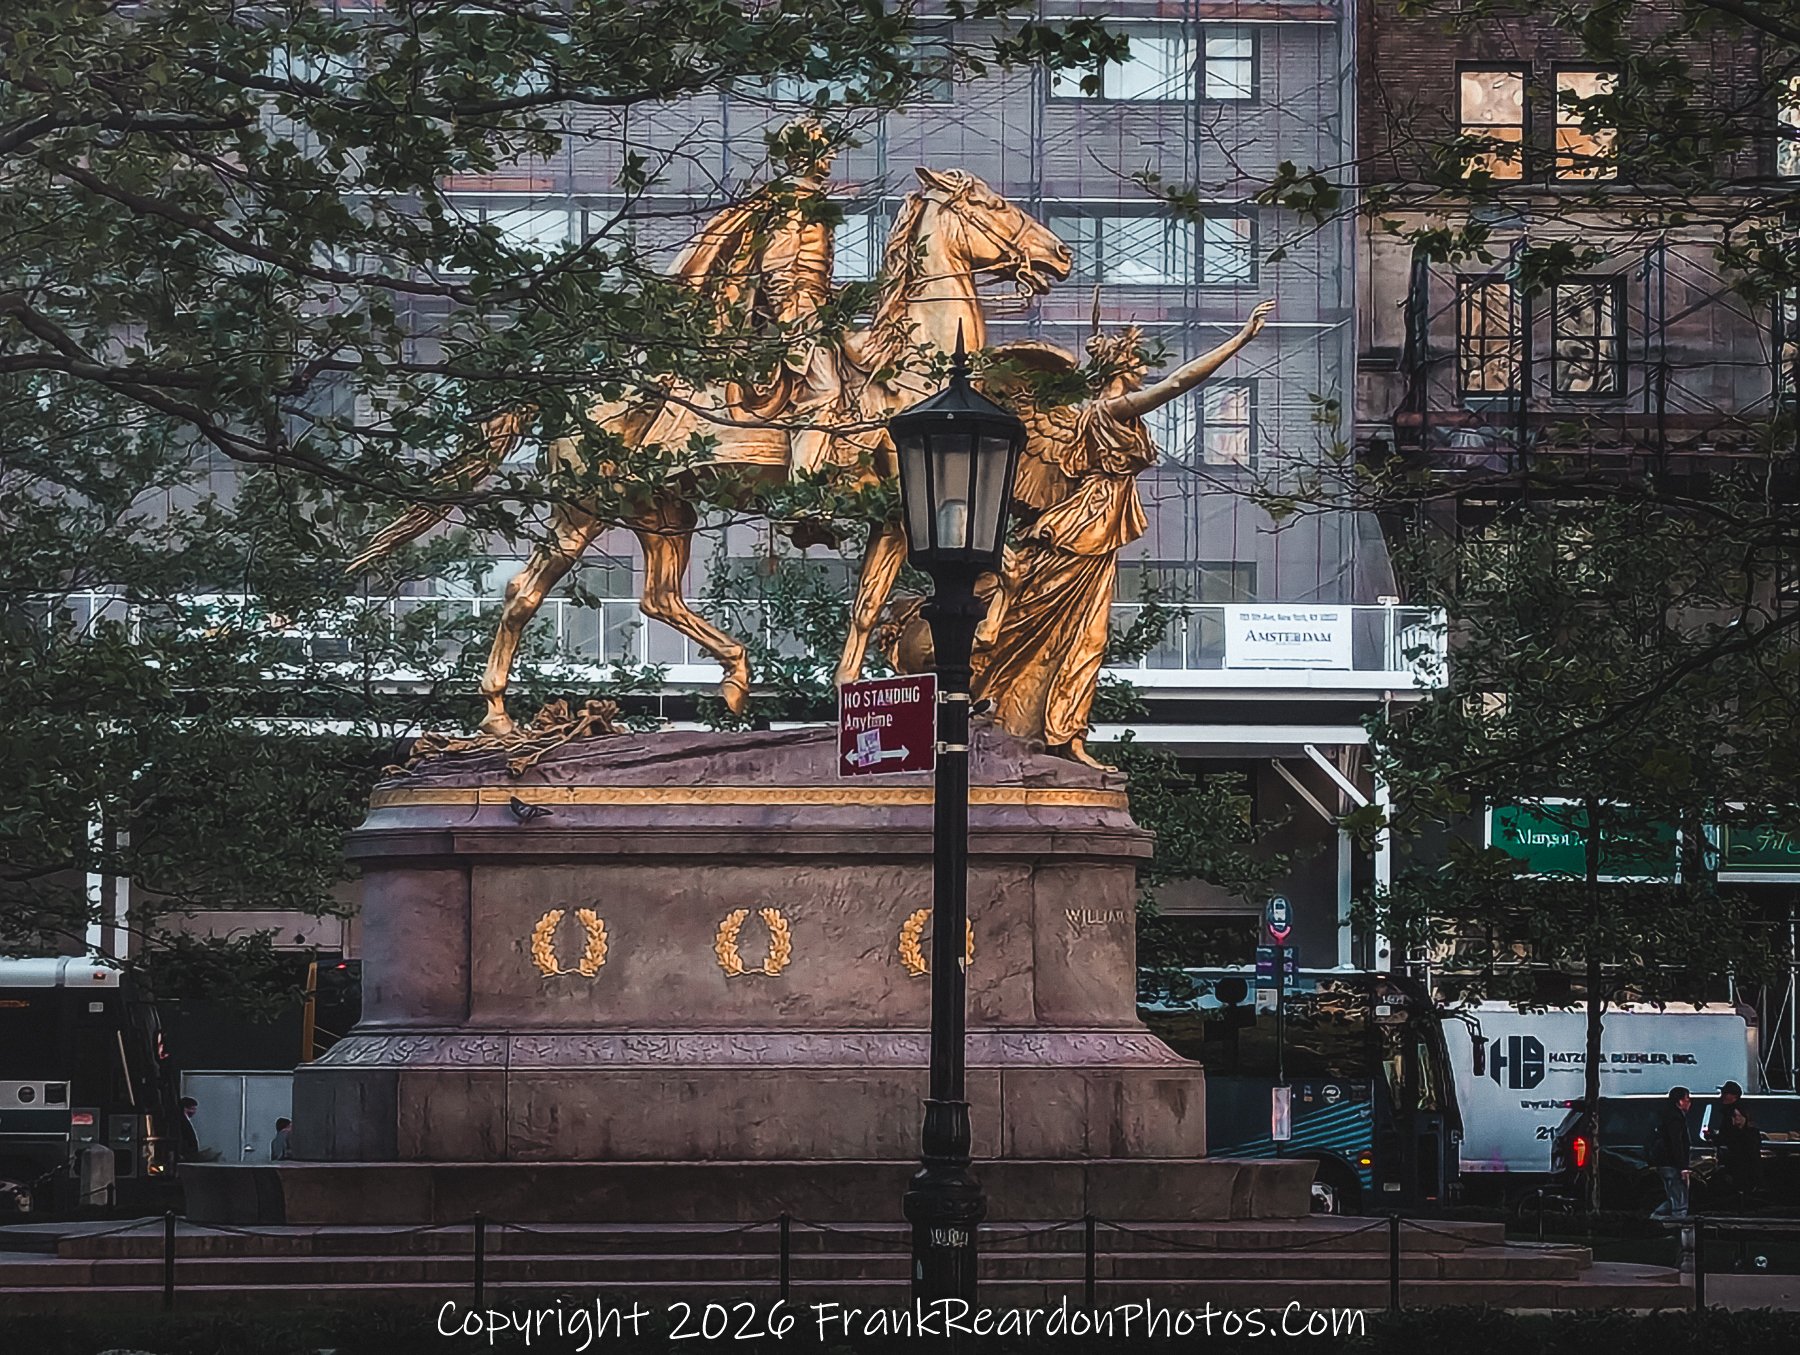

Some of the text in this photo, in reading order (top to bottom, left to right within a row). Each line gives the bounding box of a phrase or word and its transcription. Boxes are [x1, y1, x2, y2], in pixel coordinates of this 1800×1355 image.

[844, 685, 920, 710] NO STANDING
[844, 711, 893, 731] Anytime
